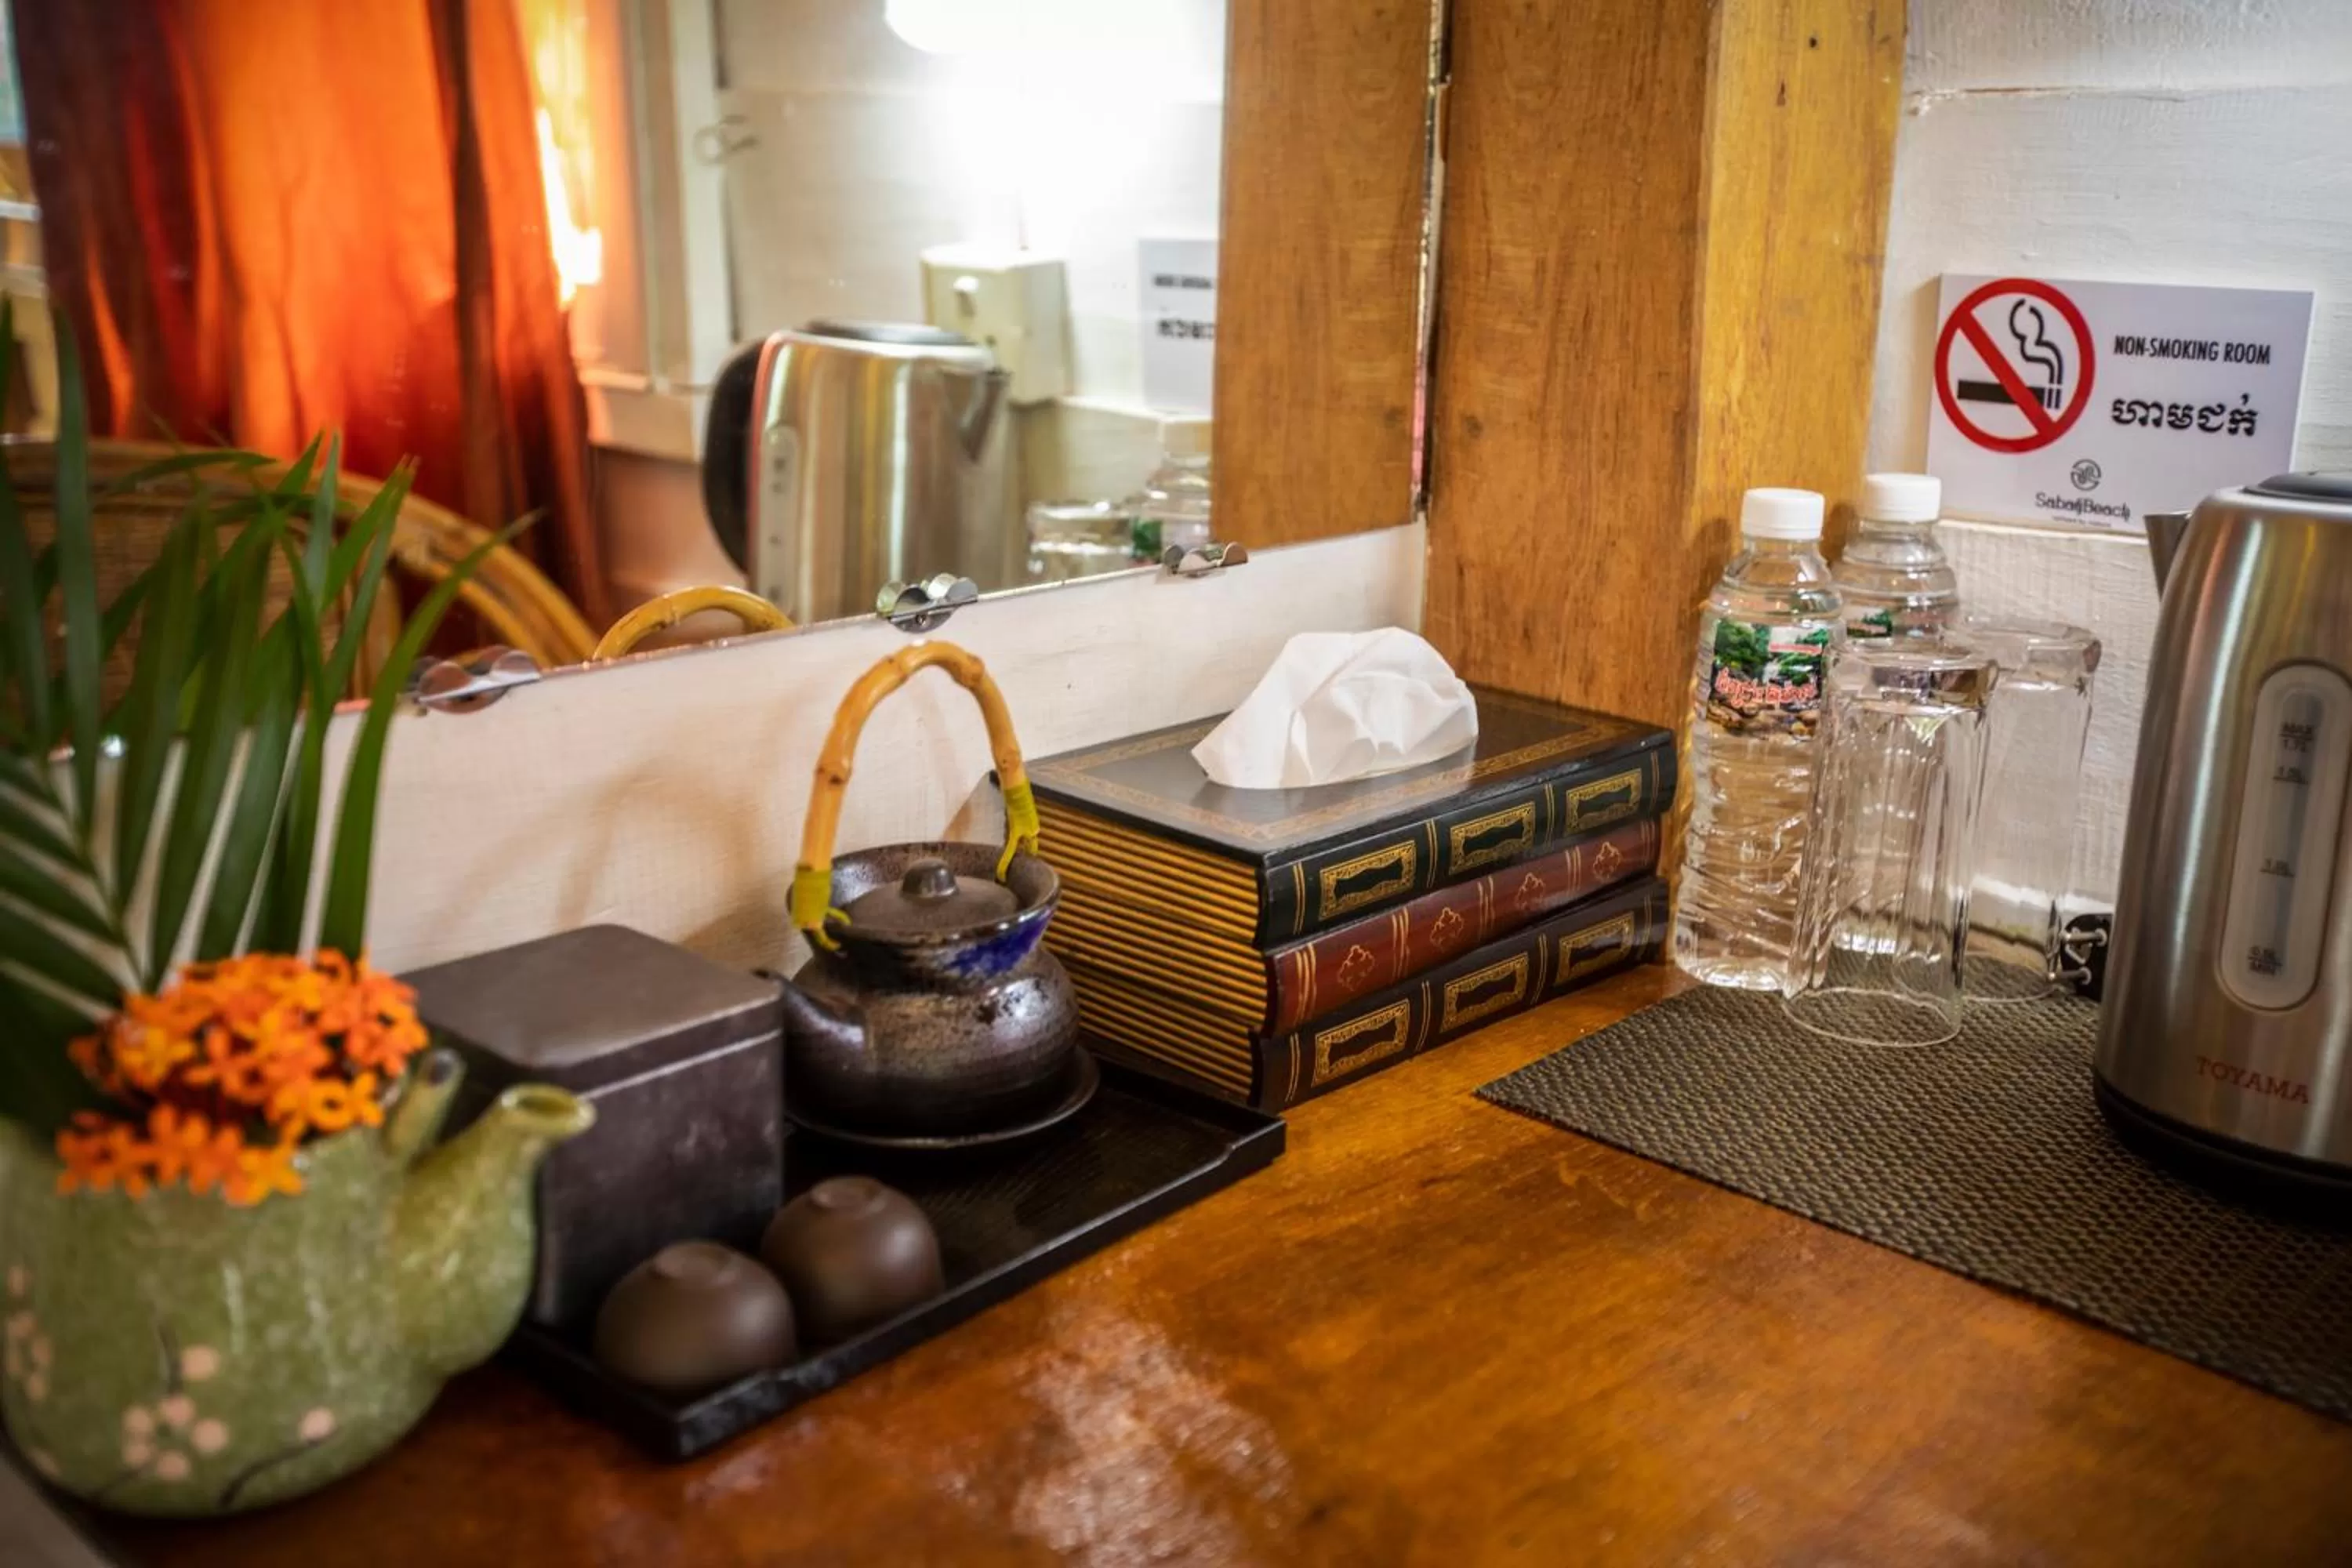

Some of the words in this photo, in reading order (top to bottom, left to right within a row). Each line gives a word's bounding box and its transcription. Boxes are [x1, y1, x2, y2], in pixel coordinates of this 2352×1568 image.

[2113, 335, 2220, 362] NON-SMOKING
[2223, 341, 2271, 365] ROOM
[2196, 1055, 2310, 1105] TOYAMA
